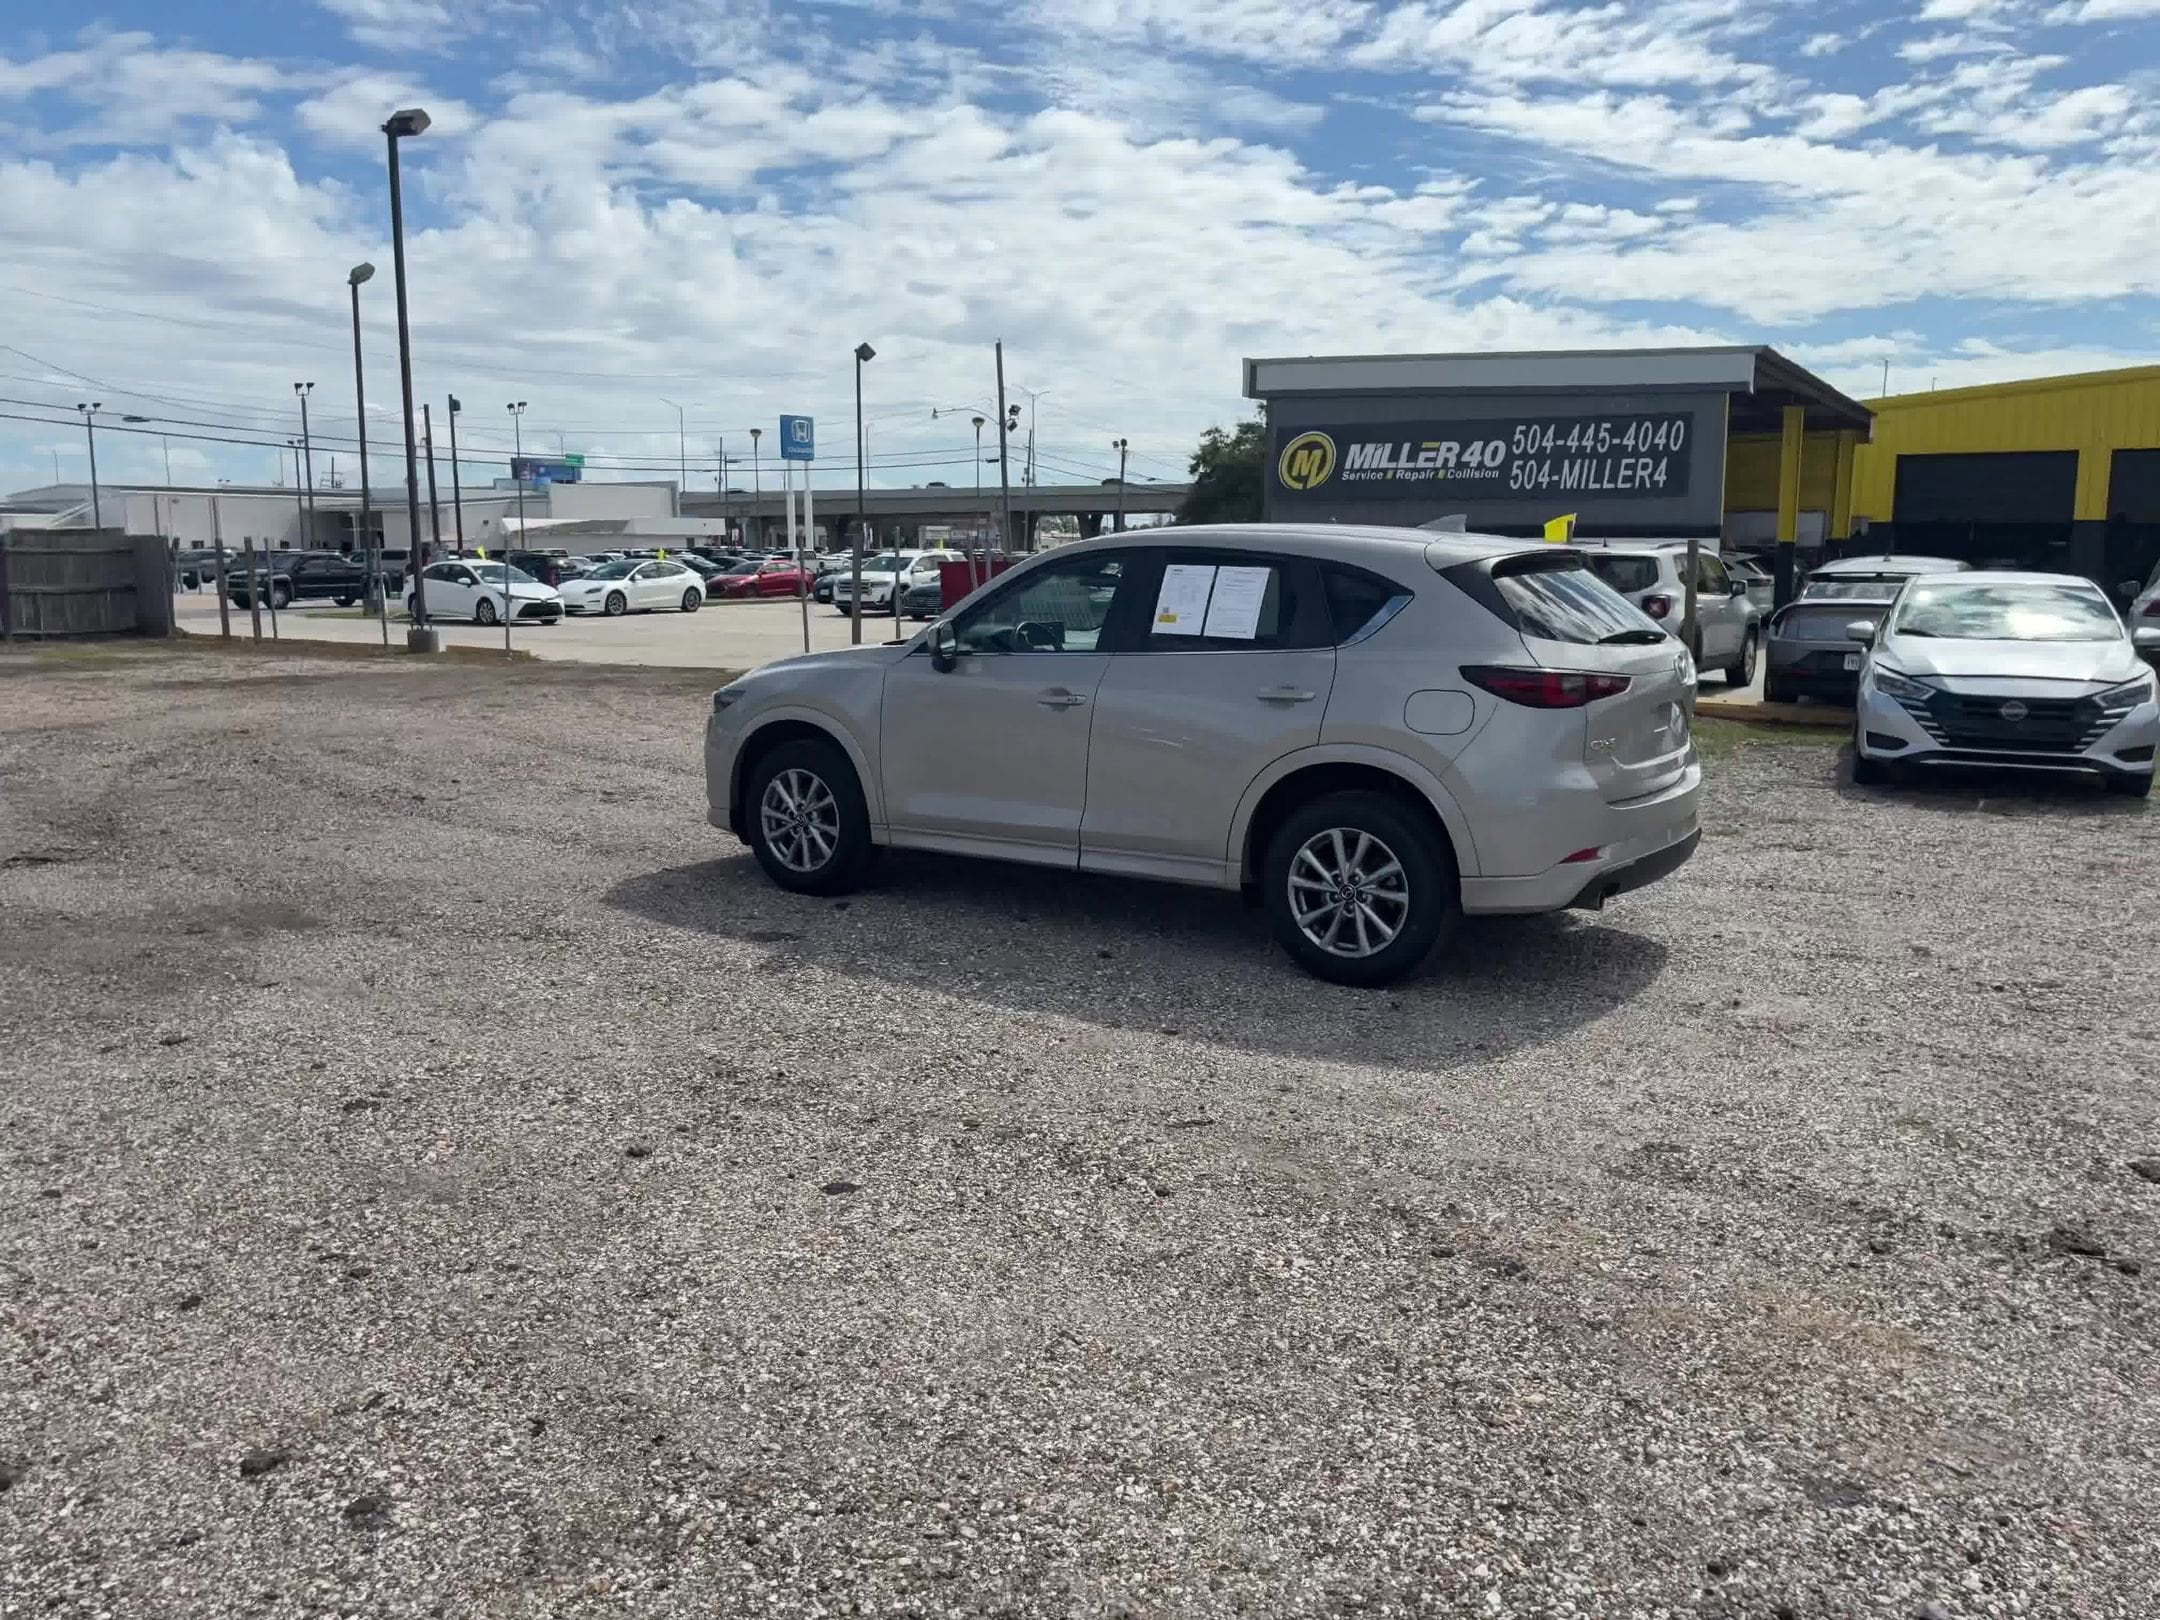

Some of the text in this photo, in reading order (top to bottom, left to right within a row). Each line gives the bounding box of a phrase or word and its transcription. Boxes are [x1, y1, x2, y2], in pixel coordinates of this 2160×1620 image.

[1512, 420, 1685, 454] 504-445-4040
[1461, 440, 1506, 467] 40
[1342, 468, 1499, 481] Service Repair Collision
[1510, 456, 1668, 489] 504-MILLER4
